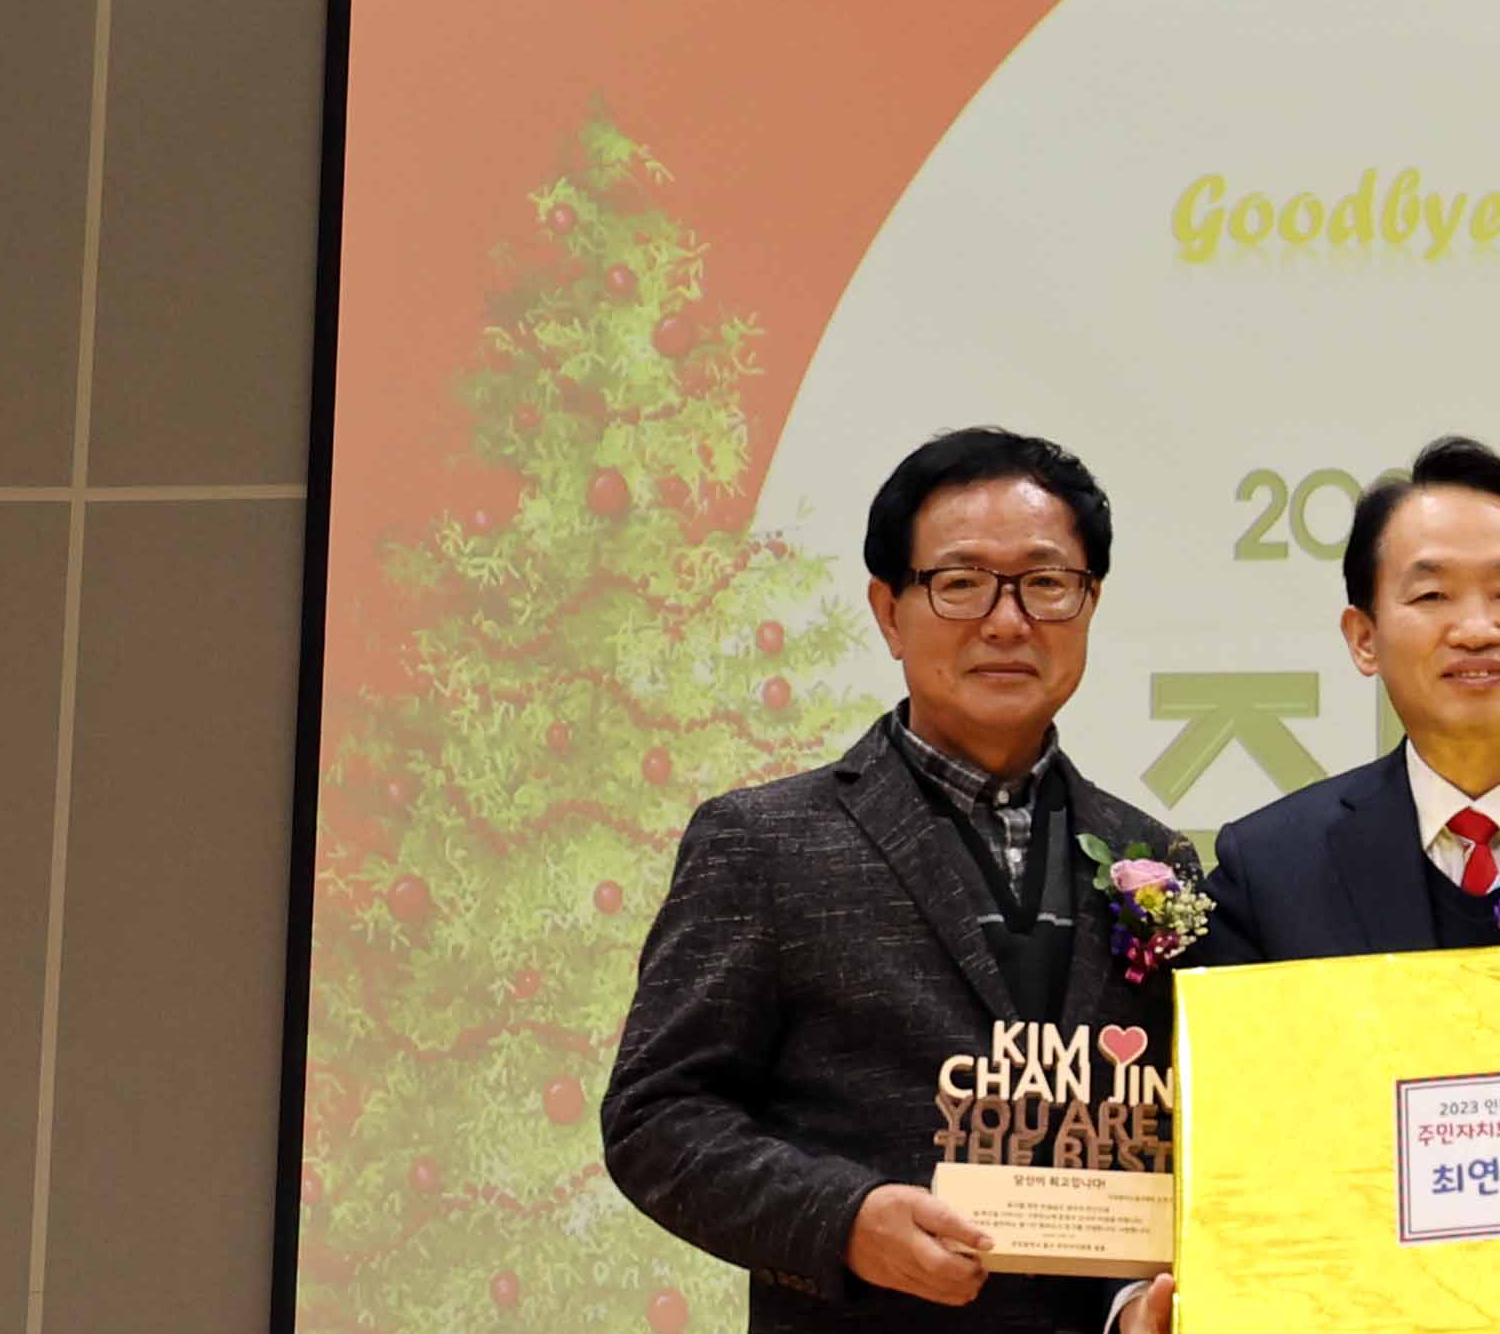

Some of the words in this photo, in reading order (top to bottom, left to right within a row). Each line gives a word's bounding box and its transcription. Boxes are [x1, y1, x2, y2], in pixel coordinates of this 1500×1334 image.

[992, 1019, 1091, 1067] KIM
[939, 1054, 1091, 1105] CHAN
[1106, 1064, 1174, 1109] JIN
[935, 1091, 1050, 1135] YOU
[1060, 1099, 1159, 1145] ARE
[1439, 1100, 1479, 1115] 2023
[933, 1128, 1036, 1167] THE
